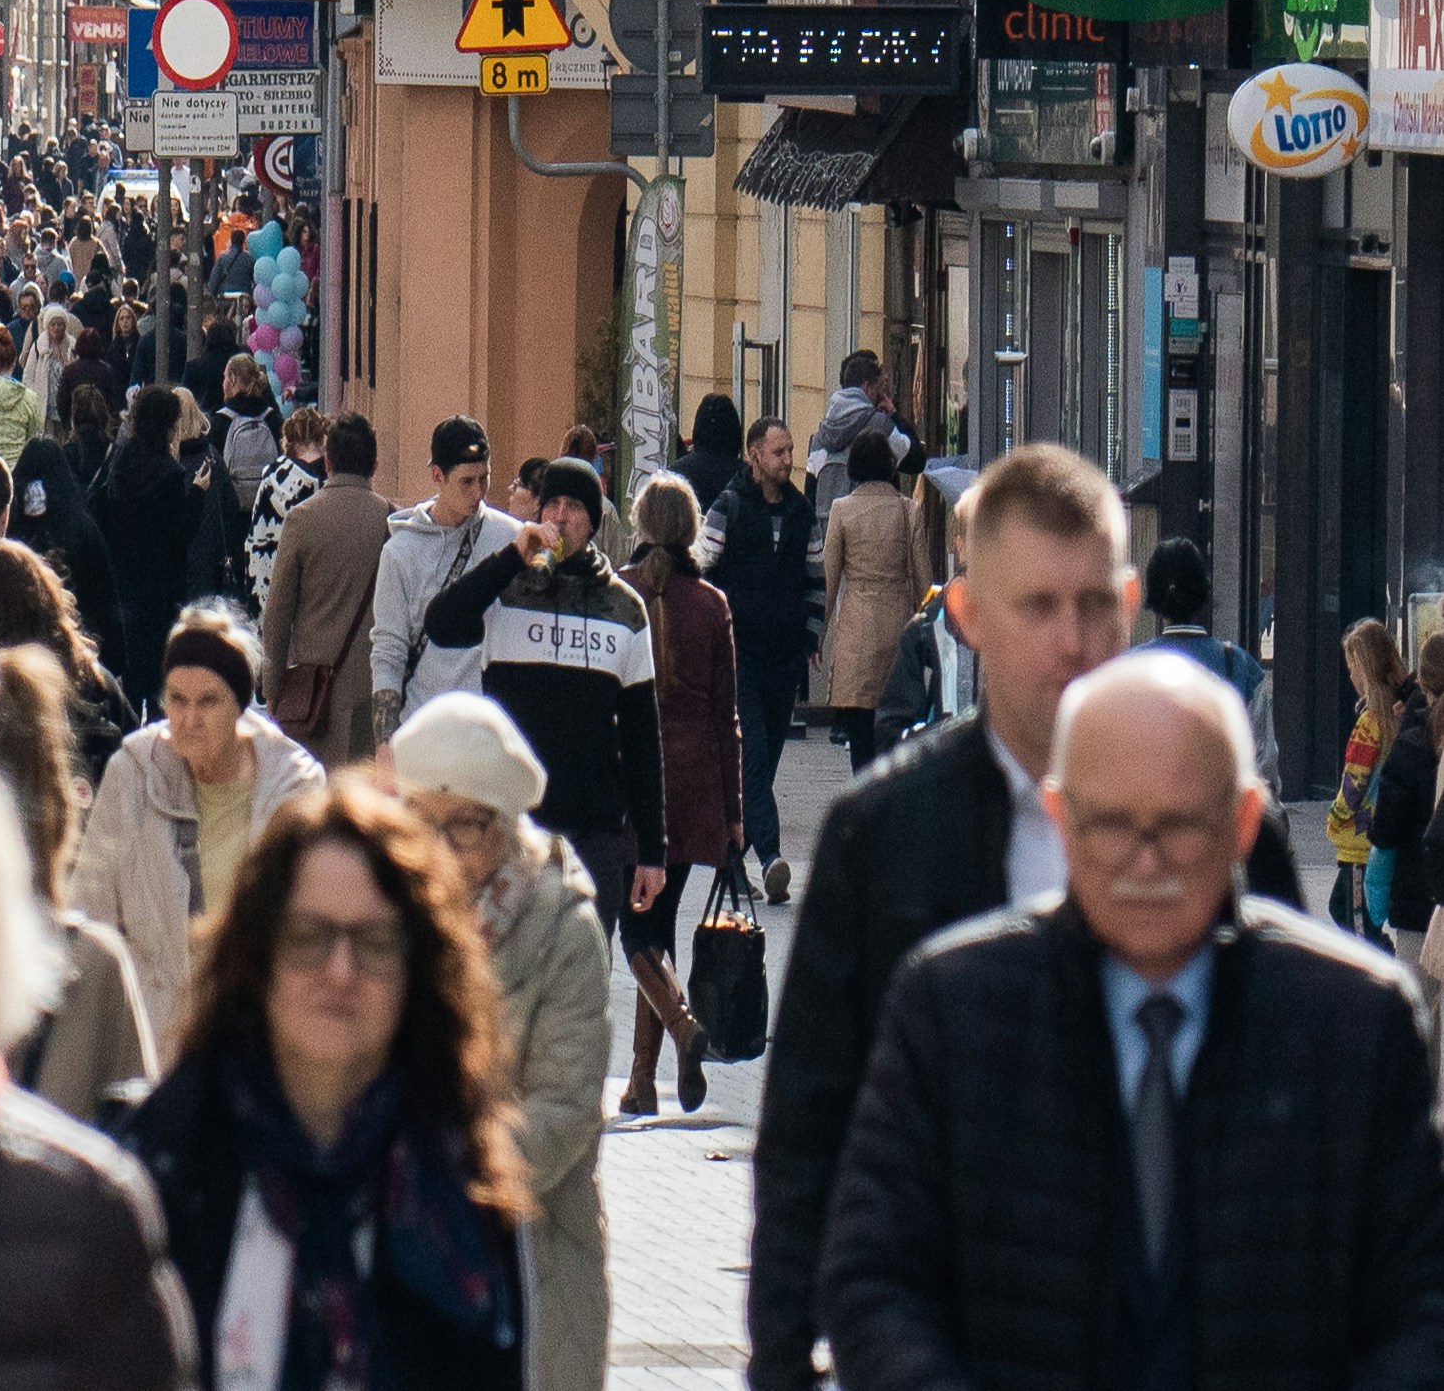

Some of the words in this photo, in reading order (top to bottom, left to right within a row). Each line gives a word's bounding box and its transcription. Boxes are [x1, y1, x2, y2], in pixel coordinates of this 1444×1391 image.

[72, 21, 126, 39] VENUS
[238, 16, 308, 39] TIUMY
[238, 44, 309, 63] IELOWE
[492, 61, 507, 89] 8
[518, 69, 539, 88] m
[162, 97, 180, 108] Nie
[263, 90, 312, 101] SREBRO
[129, 110, 150, 123] Nie
[1274, 104, 1347, 152] LOTTO
[527, 623, 617, 654] GUESS
